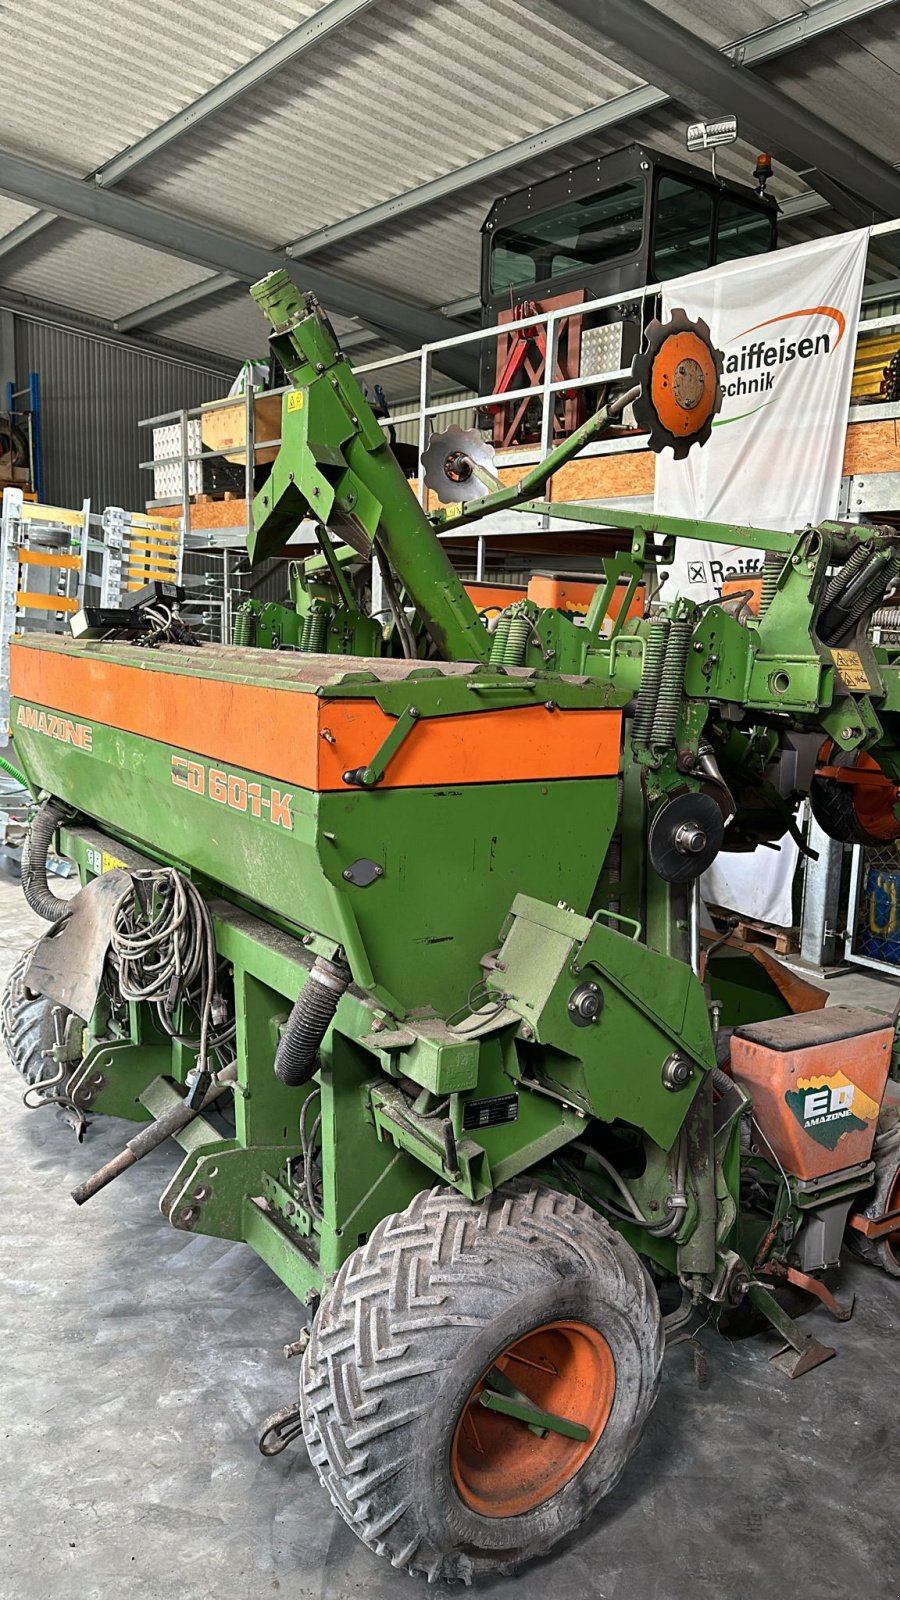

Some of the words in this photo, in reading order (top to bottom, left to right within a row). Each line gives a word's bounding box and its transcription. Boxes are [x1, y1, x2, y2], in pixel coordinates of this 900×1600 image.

[720, 371, 775, 398] echnik
[16, 704, 93, 752] AMAZONE
[171, 754, 204, 795] ED
[209, 768, 293, 831] 601-K
[803, 1084, 855, 1119] ED
[803, 1109, 852, 1129] AMAZONE
